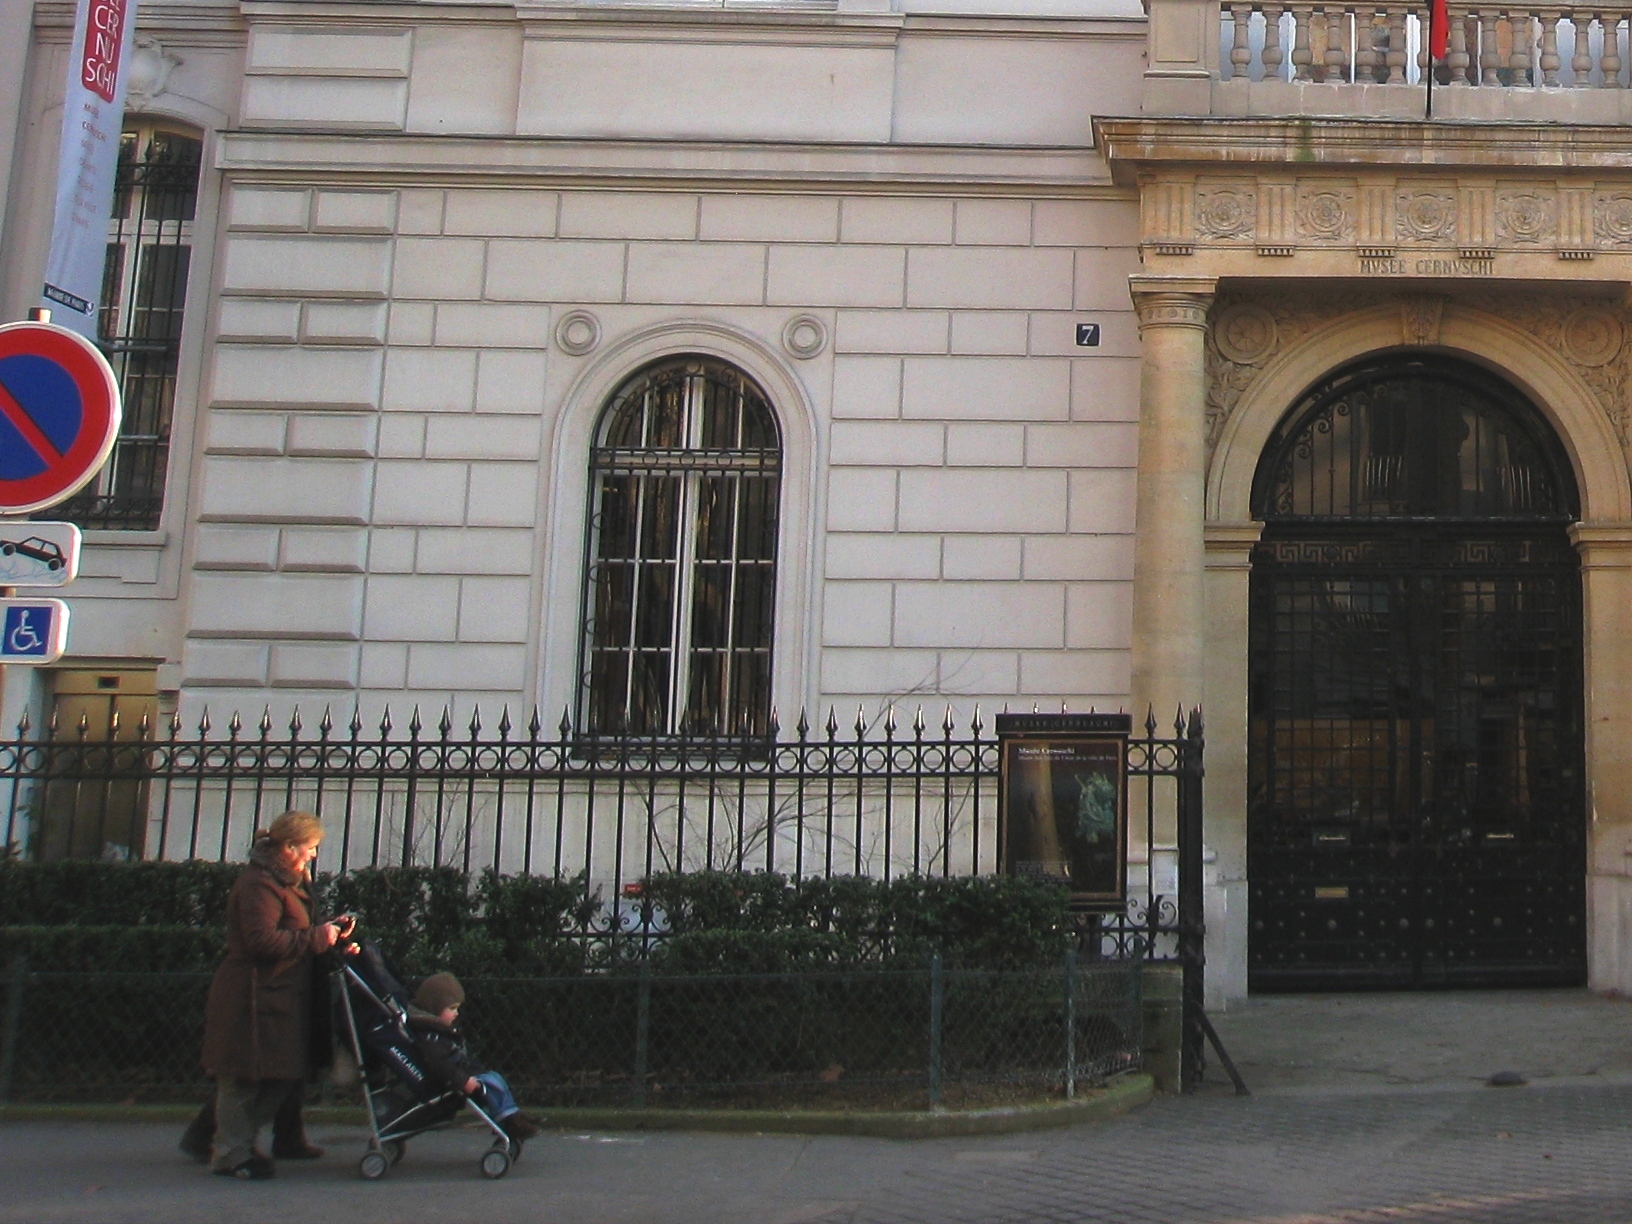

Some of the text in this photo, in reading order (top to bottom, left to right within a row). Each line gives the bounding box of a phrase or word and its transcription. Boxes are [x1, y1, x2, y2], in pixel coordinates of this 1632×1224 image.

[95, 5, 120, 39] CER
[95, 32, 115, 64] NU
[85, 58, 116, 95] SCHI
[1081, 325, 1095, 345] 7
